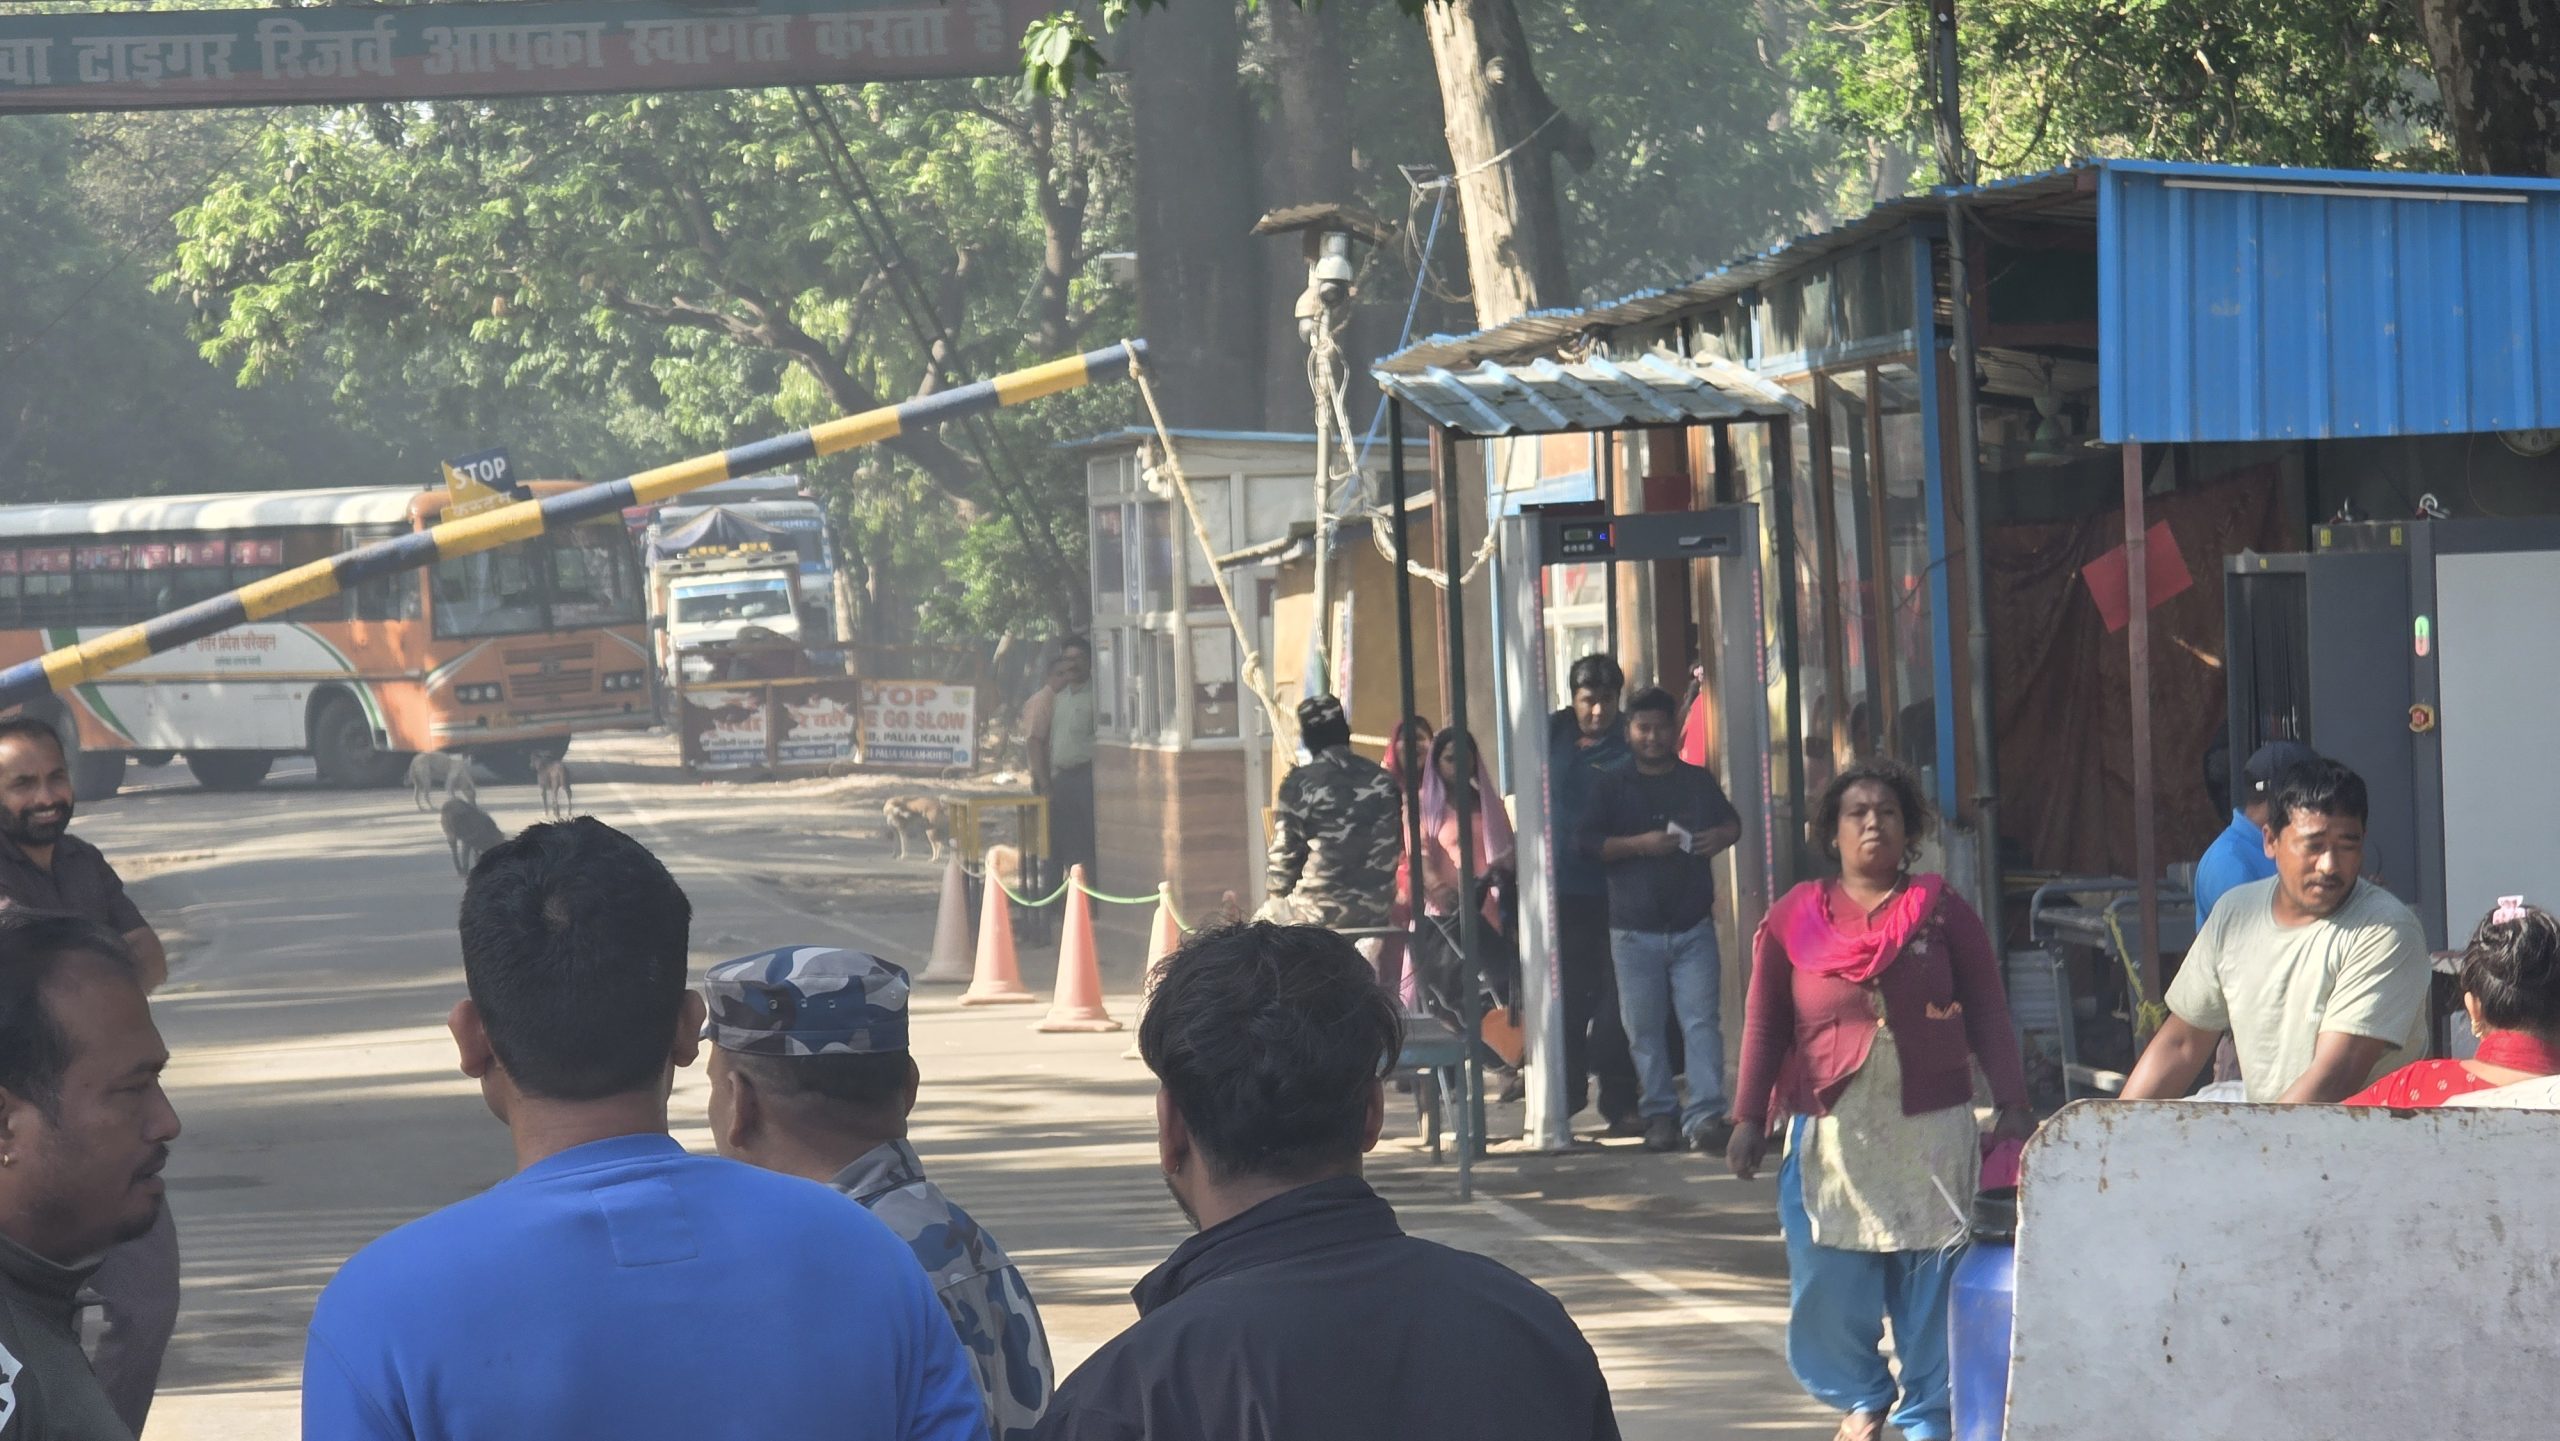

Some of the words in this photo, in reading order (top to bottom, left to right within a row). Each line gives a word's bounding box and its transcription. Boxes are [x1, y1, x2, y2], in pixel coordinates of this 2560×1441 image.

[71, 33, 238, 88] टाइगर
[254, 14, 397, 79] रिजर्व
[422, 22, 606, 75] आपका
[623, 14, 793, 66] स्वागत
[808, 8, 951, 59] करता
[452, 457, 506, 490] STOP
[883, 709, 910, 728] GO
[915, 710, 966, 730] SLOW
[883, 732, 917, 742] PALIA
[920, 733, 960, 744] KALAN
